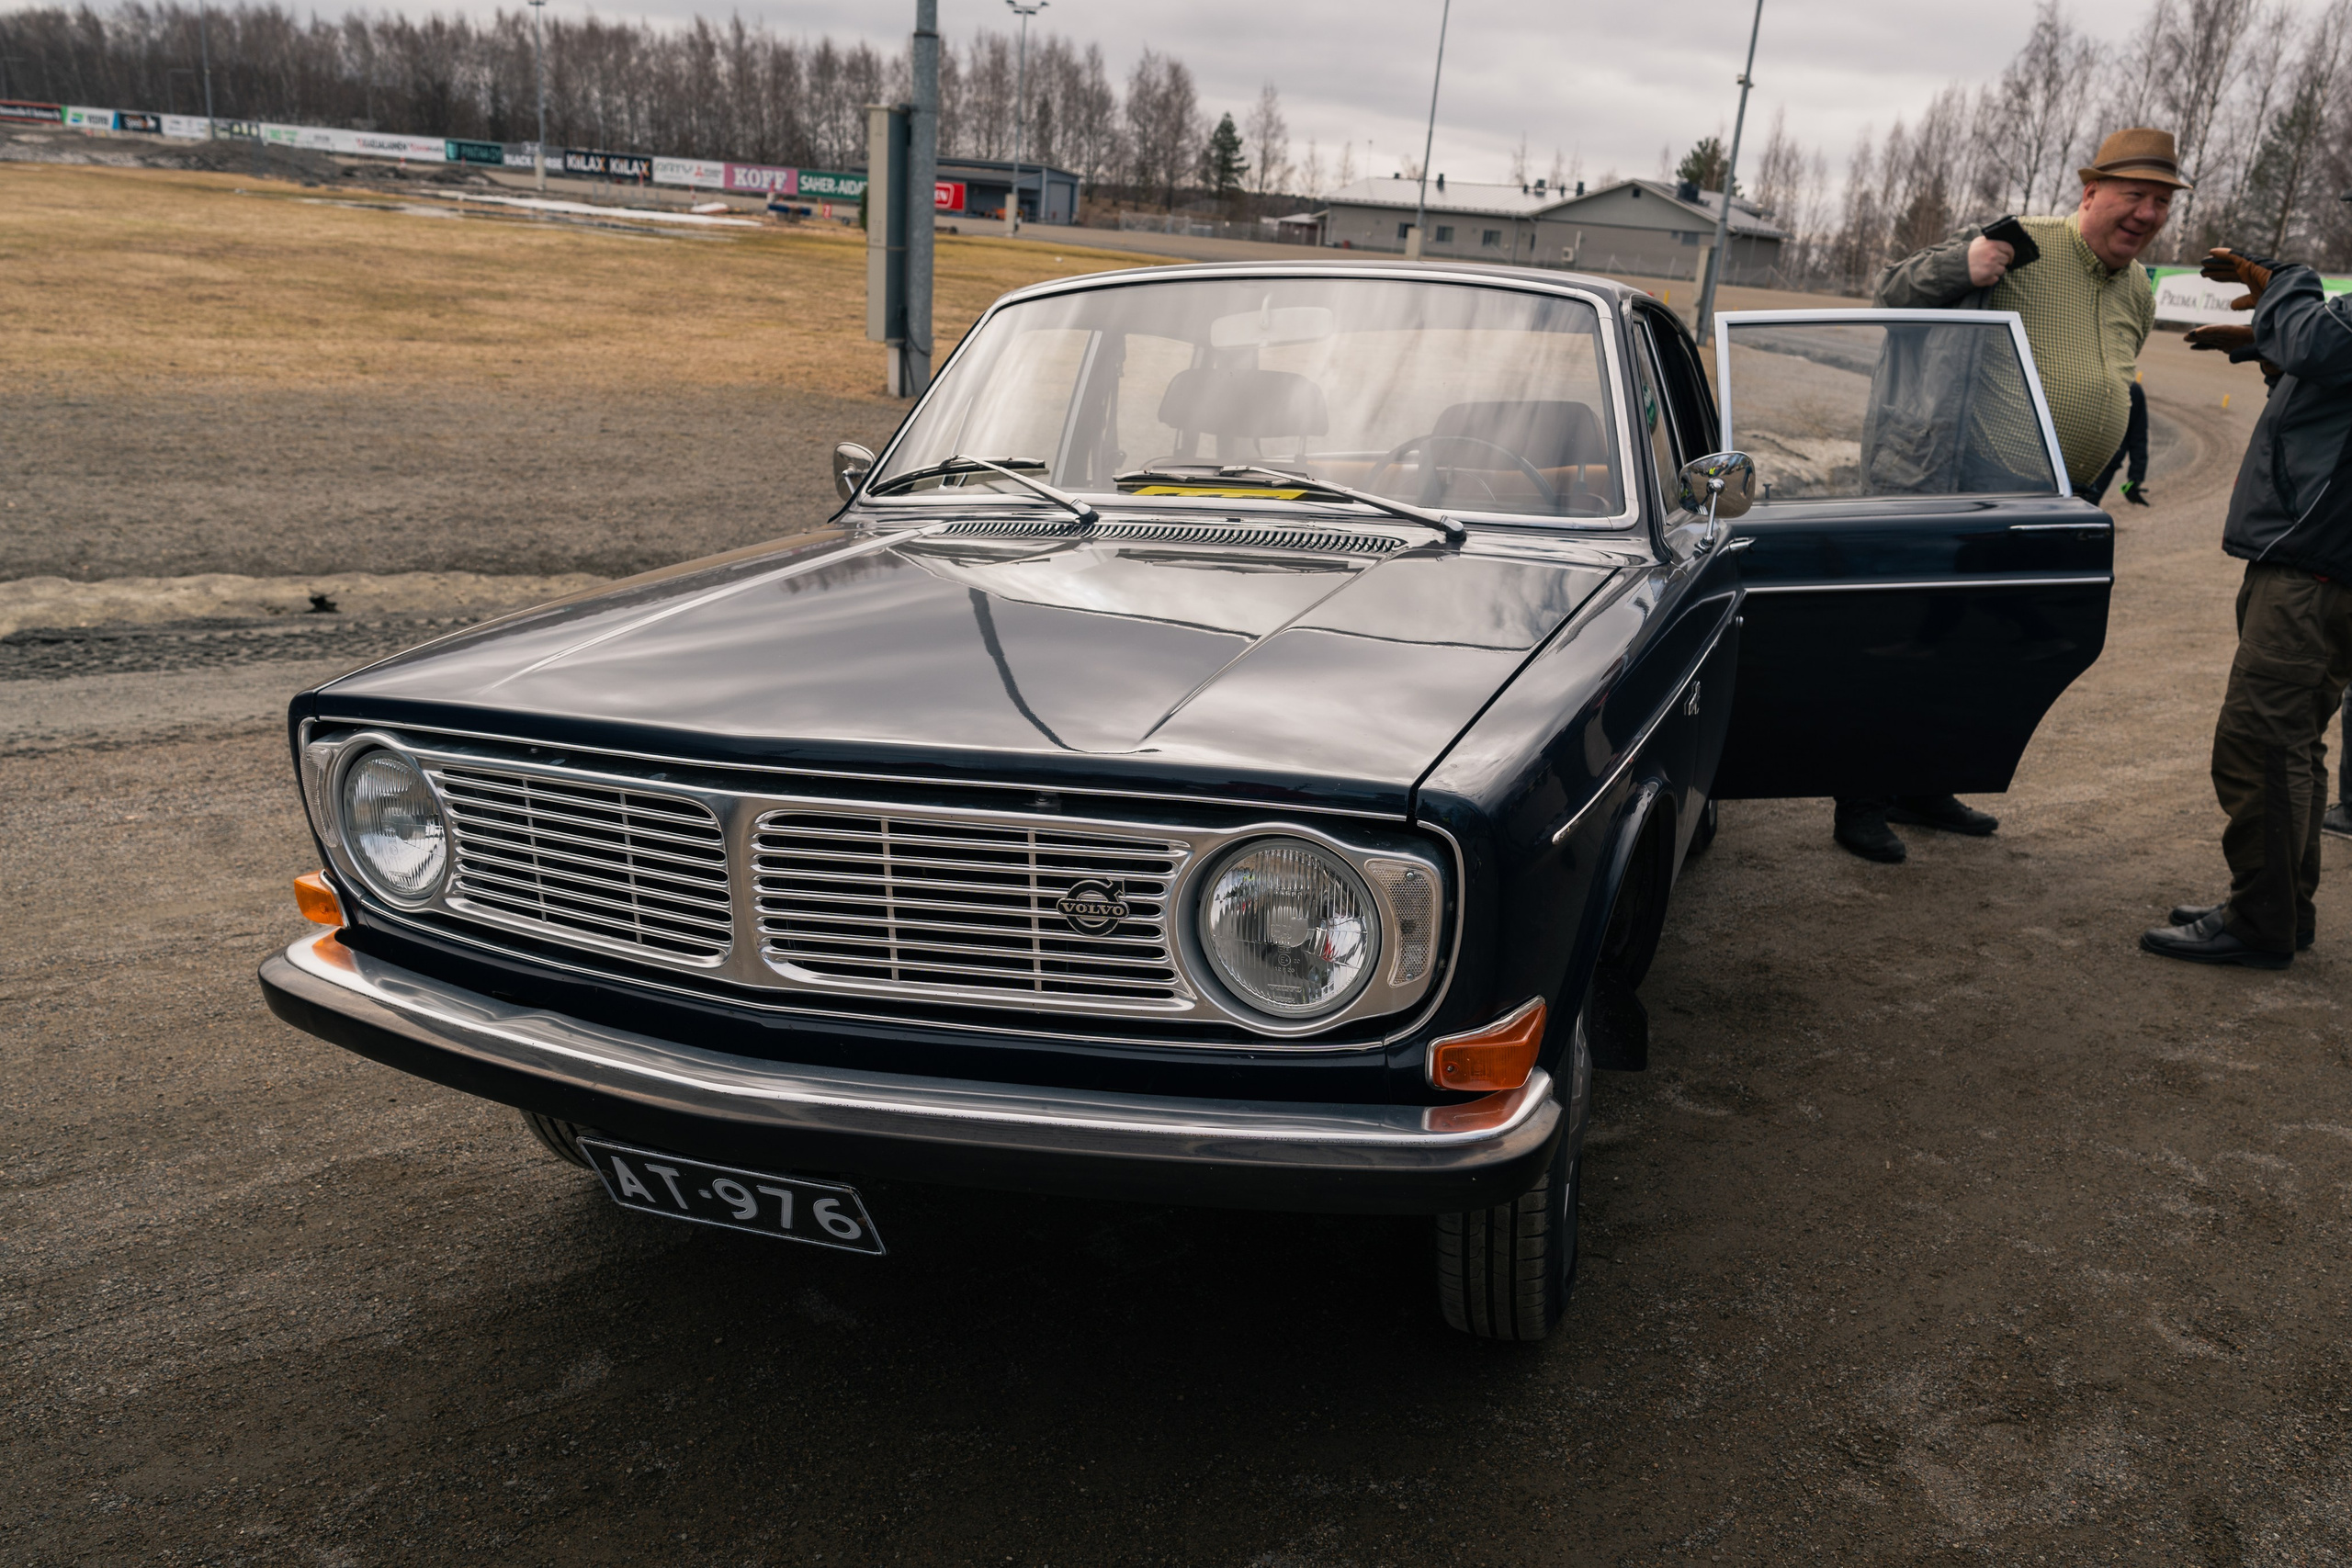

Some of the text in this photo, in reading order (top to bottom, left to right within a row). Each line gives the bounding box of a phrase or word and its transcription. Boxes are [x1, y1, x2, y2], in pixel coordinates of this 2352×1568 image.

[503, 153, 533, 167] BLACK
[732, 166, 787, 189] KOFF
[2160, 289, 2232, 311] PRIMA TIMB
[1060, 902, 1125, 916] VOLVO
[610, 1156, 863, 1240] AT-976
